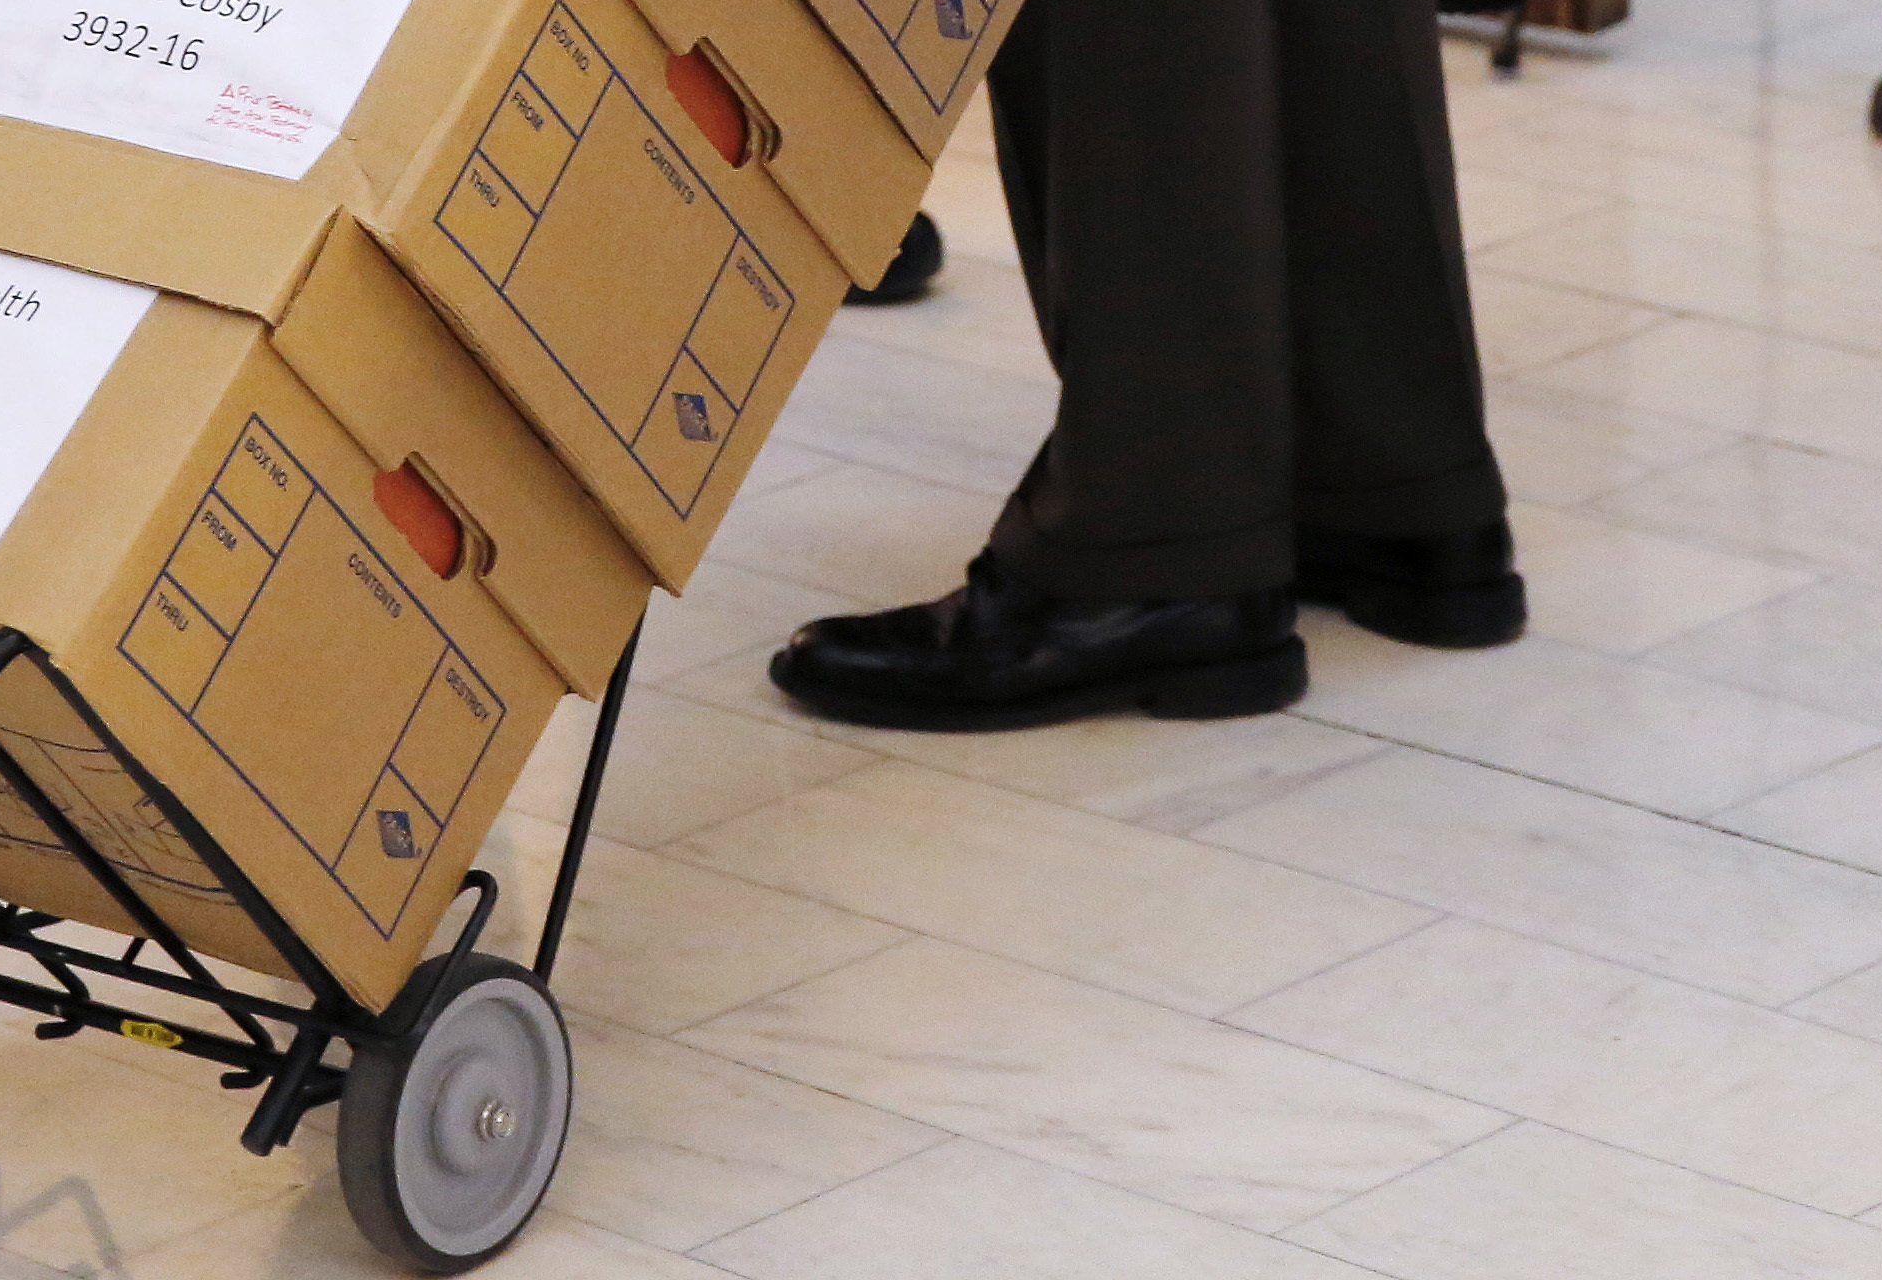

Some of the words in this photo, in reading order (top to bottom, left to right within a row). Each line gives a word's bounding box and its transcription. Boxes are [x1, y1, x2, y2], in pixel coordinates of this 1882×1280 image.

[63, 10, 203, 72] 3932-16
[550, 20, 576, 49] BOX
[510, 92, 544, 131] FROM
[470, 169, 499, 207] THRU
[645, 139, 695, 204] CONTENTS
[244, 436, 271, 469] BOX
[268, 463, 288, 492] NO.
[201, 511, 236, 552] FROM
[348, 553, 402, 618] CONTENTS
[156, 592, 189, 632] THRU
[446, 668, 490, 720] DESTROY
